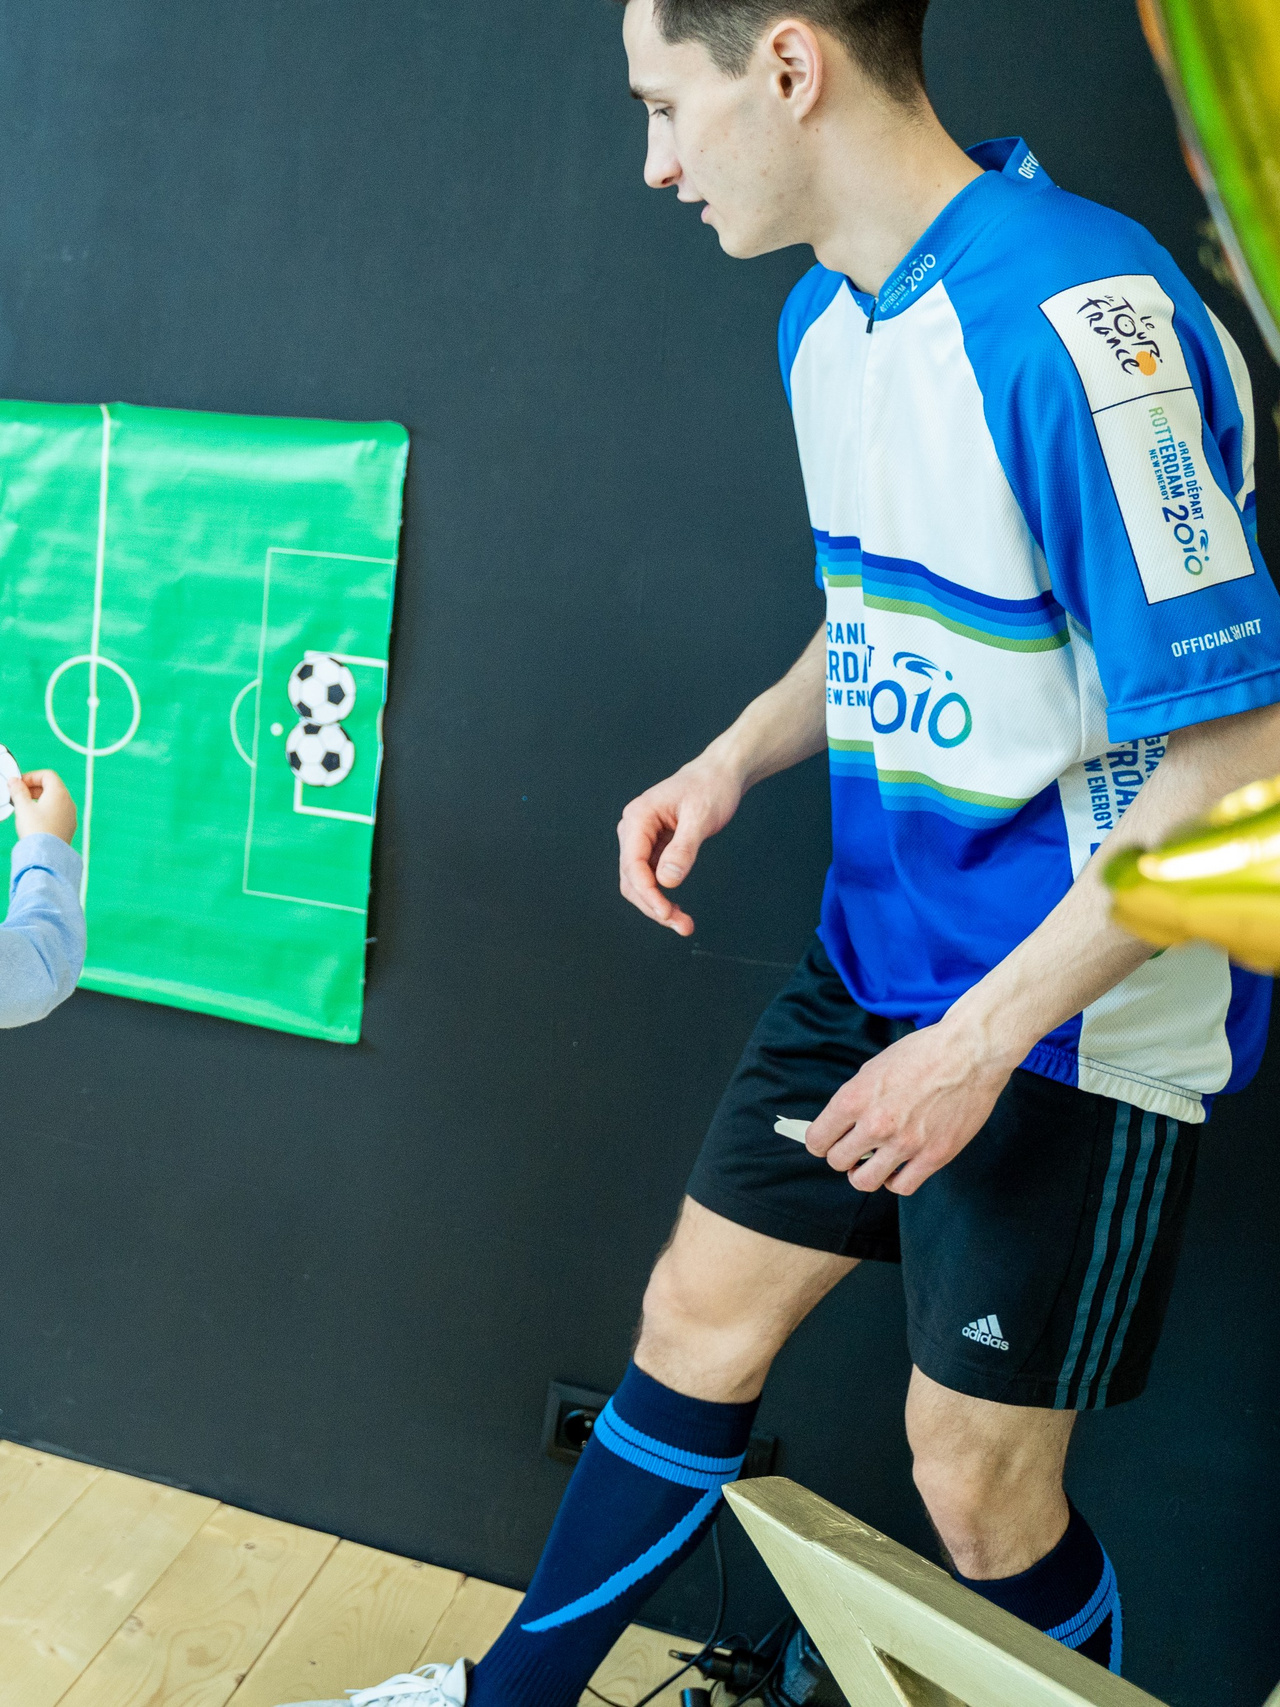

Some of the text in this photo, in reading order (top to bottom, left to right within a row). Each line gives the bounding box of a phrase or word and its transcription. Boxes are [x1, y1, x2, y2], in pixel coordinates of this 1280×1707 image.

[905, 253, 936, 292] 2010
[1148, 406, 1185, 499] ROTTERDAM
[1148, 448, 1170, 501] NEW ENERGY
[1178, 440, 1204, 520] GRAND DÉPART
[1161, 504, 1203, 576] 2010
[1171, 618, 1261, 657] OFFICIAL SHIRT
[1087, 776, 1113, 830] ENERGY
[961, 1326, 1010, 1351] adidas
